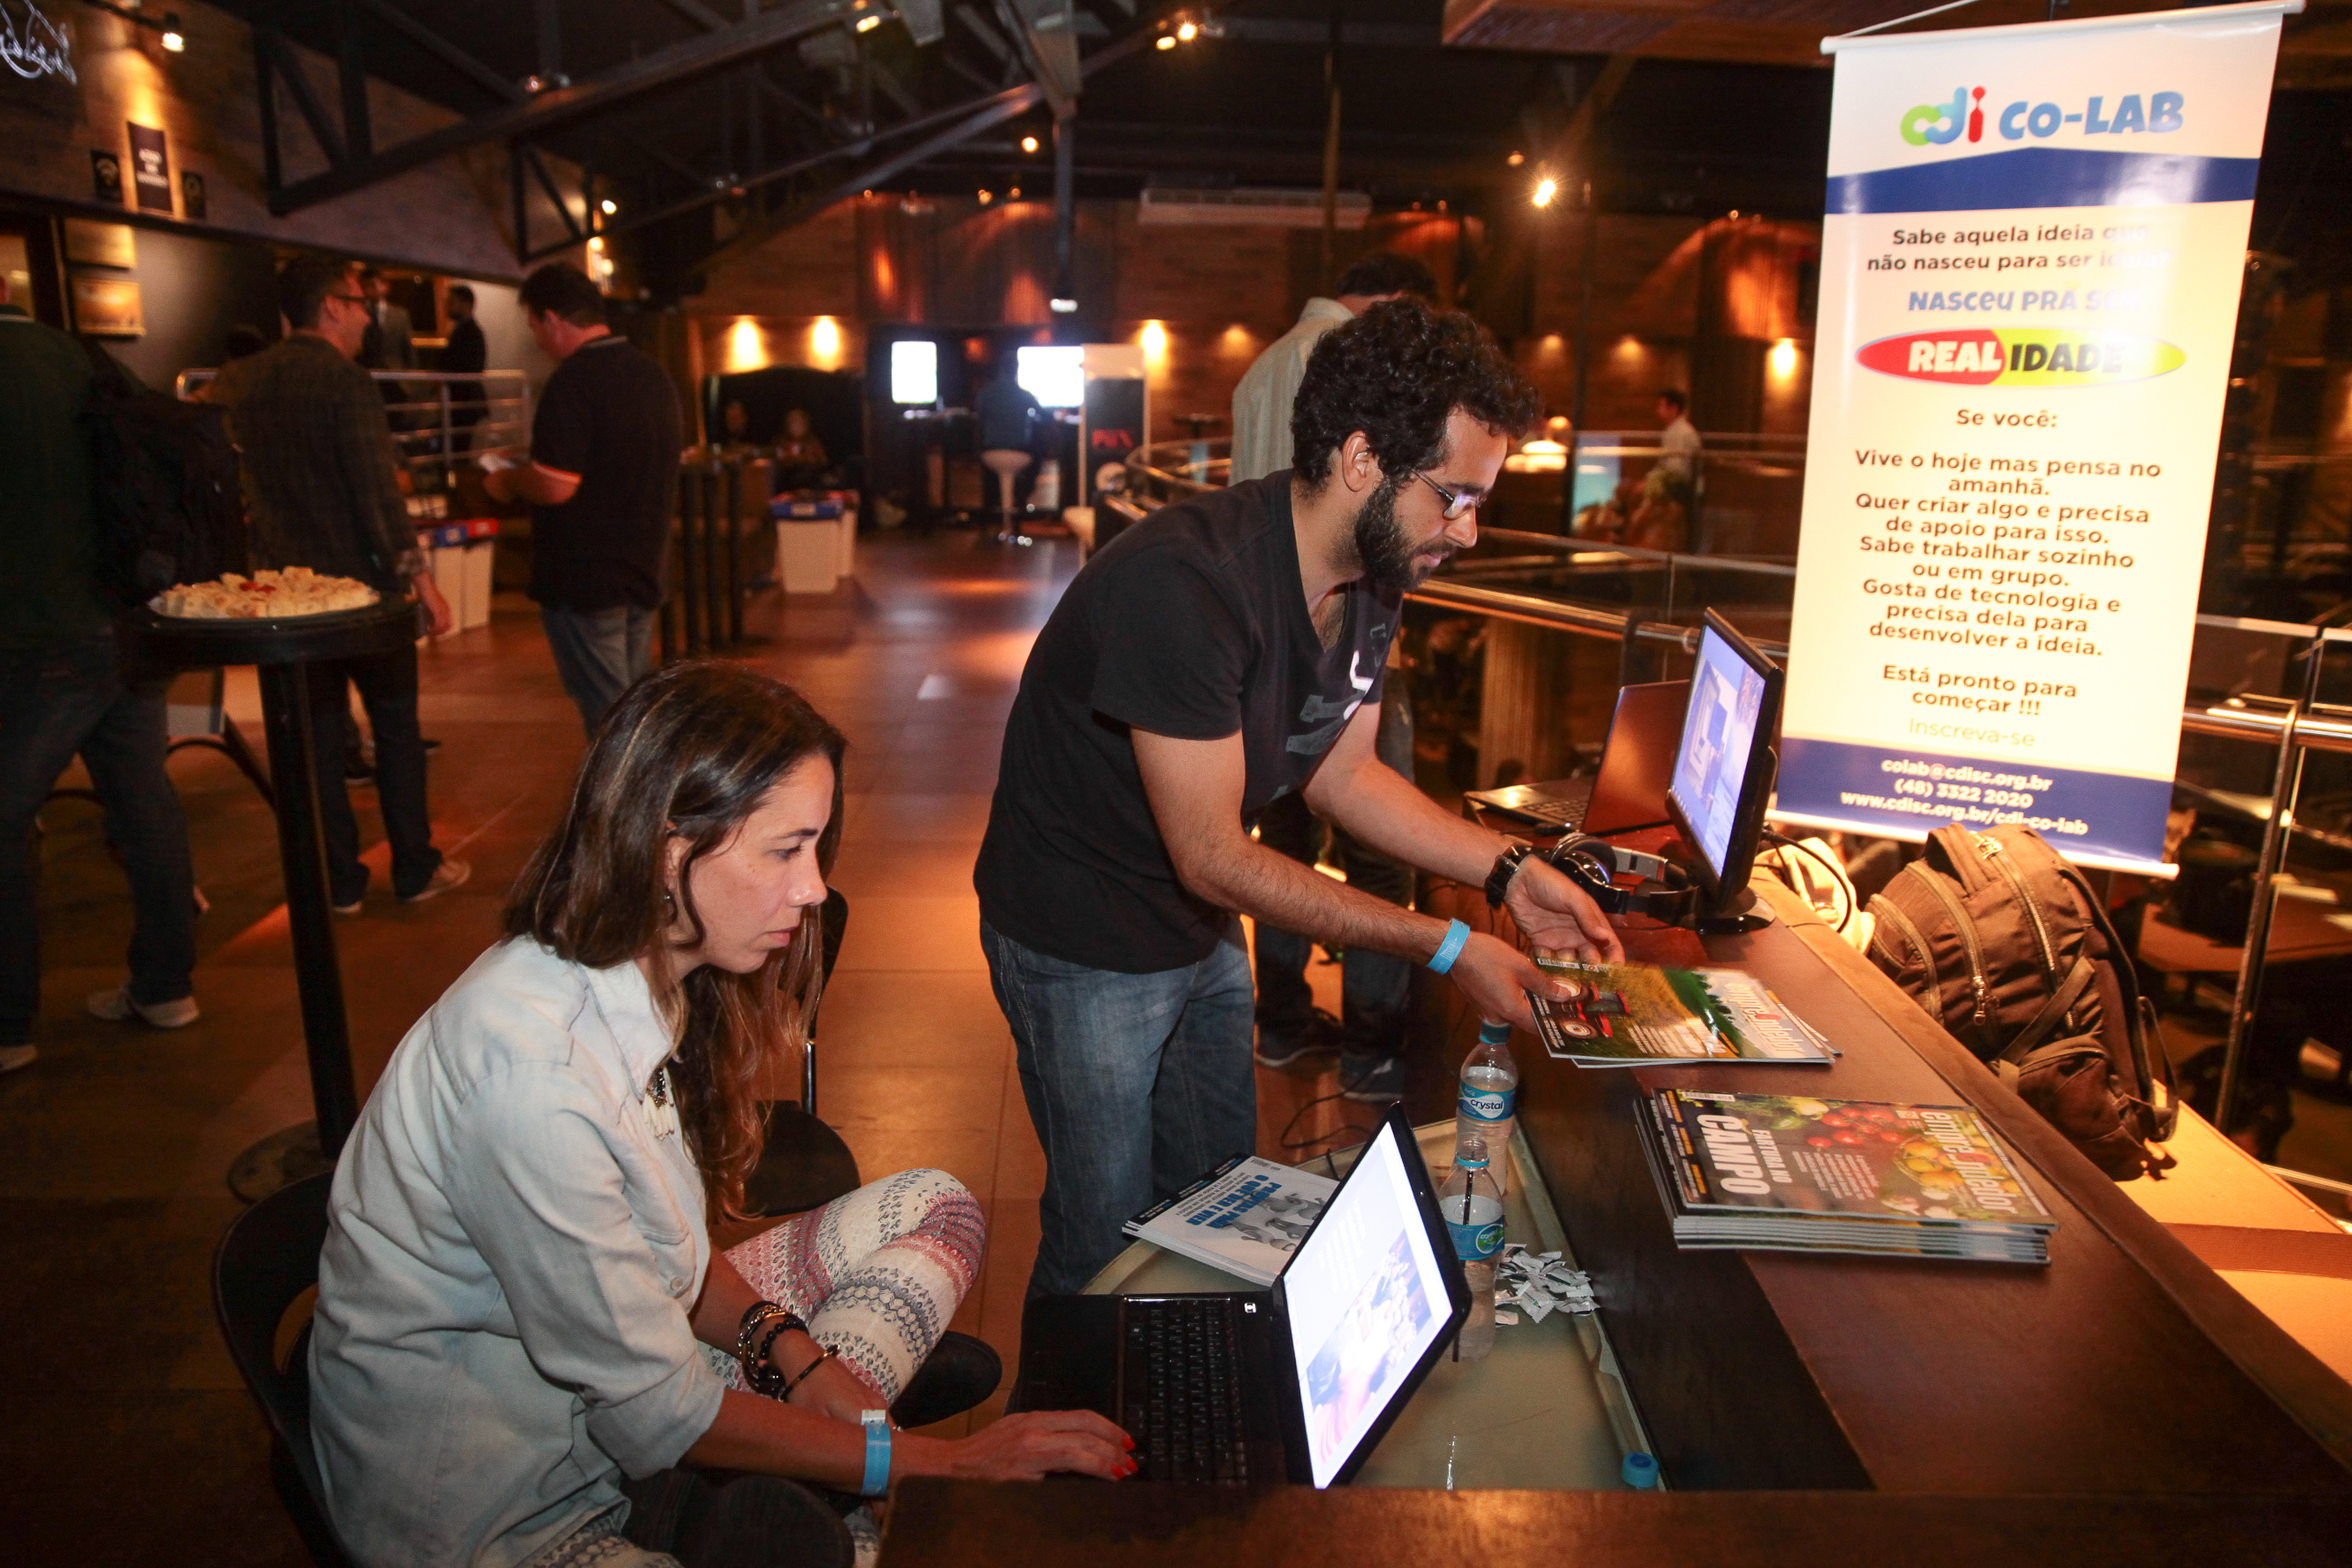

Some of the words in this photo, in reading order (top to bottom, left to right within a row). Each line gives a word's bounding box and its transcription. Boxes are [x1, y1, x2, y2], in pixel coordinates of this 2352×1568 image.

[1900, 86, 1986, 146] cdi
[1998, 90, 2185, 141] CO-LAB
[1893, 228, 1946, 245] Sabe
[1953, 226, 2029, 246] aquela
[2037, 224, 2094, 241] ideia
[1867, 254, 1906, 271] não
[1914, 256, 1990, 270] nasceu
[1997, 255, 2048, 272] para
[2057, 254, 2093, 267] ser
[1957, 409, 1984, 425] Se
[1994, 410, 2057, 428] você:
[1856, 449, 1903, 466] Vive
[1911, 455, 1924, 467] o
[1932, 452, 1981, 472] hoje
[1990, 458, 2038, 472] mas
[2047, 460, 2120, 476] pensa
[2130, 463, 2161, 477] no
[1949, 478, 2049, 495] amanhã.
[1856, 493, 1910, 510] Quer
[1918, 496, 1970, 513] criar
[1977, 499, 2028, 519] algo
[2038, 505, 2049, 517] e
[2058, 505, 2149, 523] precisa
[1886, 516, 1912, 532] de
[1920, 520, 1985, 537] apoio
[1994, 526, 2046, 540] para
[2056, 524, 2110, 544] isso.
[1860, 536, 1914, 554] Sabe
[1923, 540, 2030, 561] trabalhar
[2038, 548, 2134, 568] sozinho
[1912, 564, 1940, 577] ou
[1948, 567, 1982, 580] em
[1991, 570, 2069, 587] grupo.
[1863, 578, 1926, 598] Gosta
[1934, 584, 1962, 600] de
[1971, 587, 2097, 612] tecnologia
[2107, 600, 2120, 612] e
[1887, 604, 1967, 622] precisa
[1976, 609, 2025, 627] dela
[2034, 616, 2088, 632] para
[1869, 622, 2009, 647] desenvolver
[2016, 637, 2027, 649] a
[2037, 635, 2103, 655] ideia.
[1883, 664, 1930, 684] Está
[1938, 673, 2016, 692] pronto
[2024, 681, 2077, 698] para
[1912, 692, 2011, 713] começar
[2019, 699, 2041, 715] !!!
[1909, 718, 2035, 747] Inscreva-se
[1881, 759, 2053, 791] colab@cdisc.org.br
[1895, 778, 1934, 797] (48)
[1936, 783, 1981, 802] 3322
[1983, 789, 2034, 808] 2020
[1841, 792, 2088, 835] www.cdisc.org.br/cdi-co-lab
[1726, 983, 1805, 1053] empreendedor
[1470, 1098, 1504, 1110] crystal
[1697, 1114, 1771, 1195] CAMPO
[1751, 1129, 1787, 1169] FARTURA
[1769, 1169, 1793, 1183] NO
[1919, 1112, 2019, 1214] empreendedor
[1217, 1193, 1244, 1207] DER
[1236, 1180, 1261, 1197] QUE
[1185, 1209, 1217, 1226] VIER
